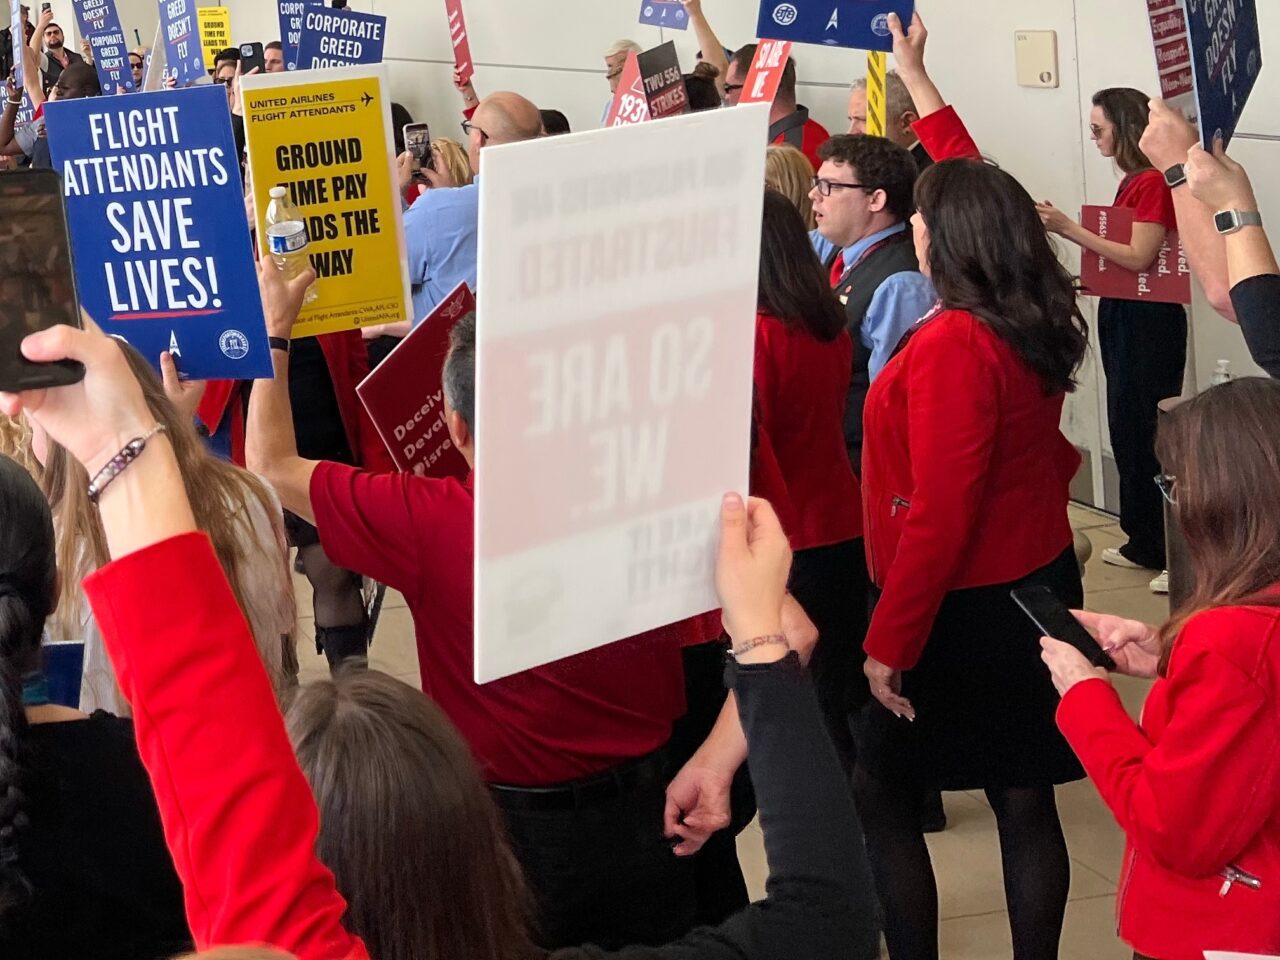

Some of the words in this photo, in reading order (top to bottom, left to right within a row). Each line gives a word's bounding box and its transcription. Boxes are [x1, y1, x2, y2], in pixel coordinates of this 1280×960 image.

[82, 5, 110, 21] DOESN'T
[280, 2, 304, 15] CORPO
[92, 19, 105, 30] FLY
[167, 15, 192, 41] DOESN'T
[306, 12, 381, 40] CORPORATE
[91, 33, 124, 47] CORPORATE
[100, 46, 119, 58] GREED
[177, 40, 188, 60] FLY
[320, 36, 362, 59] GREED
[100, 57, 124, 70] DOESN'T
[109, 70, 121, 81] FLY
[1221, 39, 1239, 96] FLY
[644, 74, 664, 94] TWU
[664, 67, 680, 85] 556
[250, 97, 287, 109] UNITED
[290, 93, 335, 105] AIRLINES
[251, 111, 287, 122] FLIGHT
[289, 104, 356, 119] ATTENDANTS
[618, 92, 647, 122] 1931
[650, 85, 685, 116] STRIKES
[88, 106, 179, 151] FLIGHT
[276, 137, 362, 171] GROUND
[63, 147, 228, 197] ATTENDANTS
[331, 173, 367, 202] PAY
[106, 197, 200, 254] SAVE
[341, 208, 380, 237] THE
[310, 248, 354, 278] WAY
[104, 256, 222, 312] LIVES!
[393, 390, 444, 442] Deceiv
